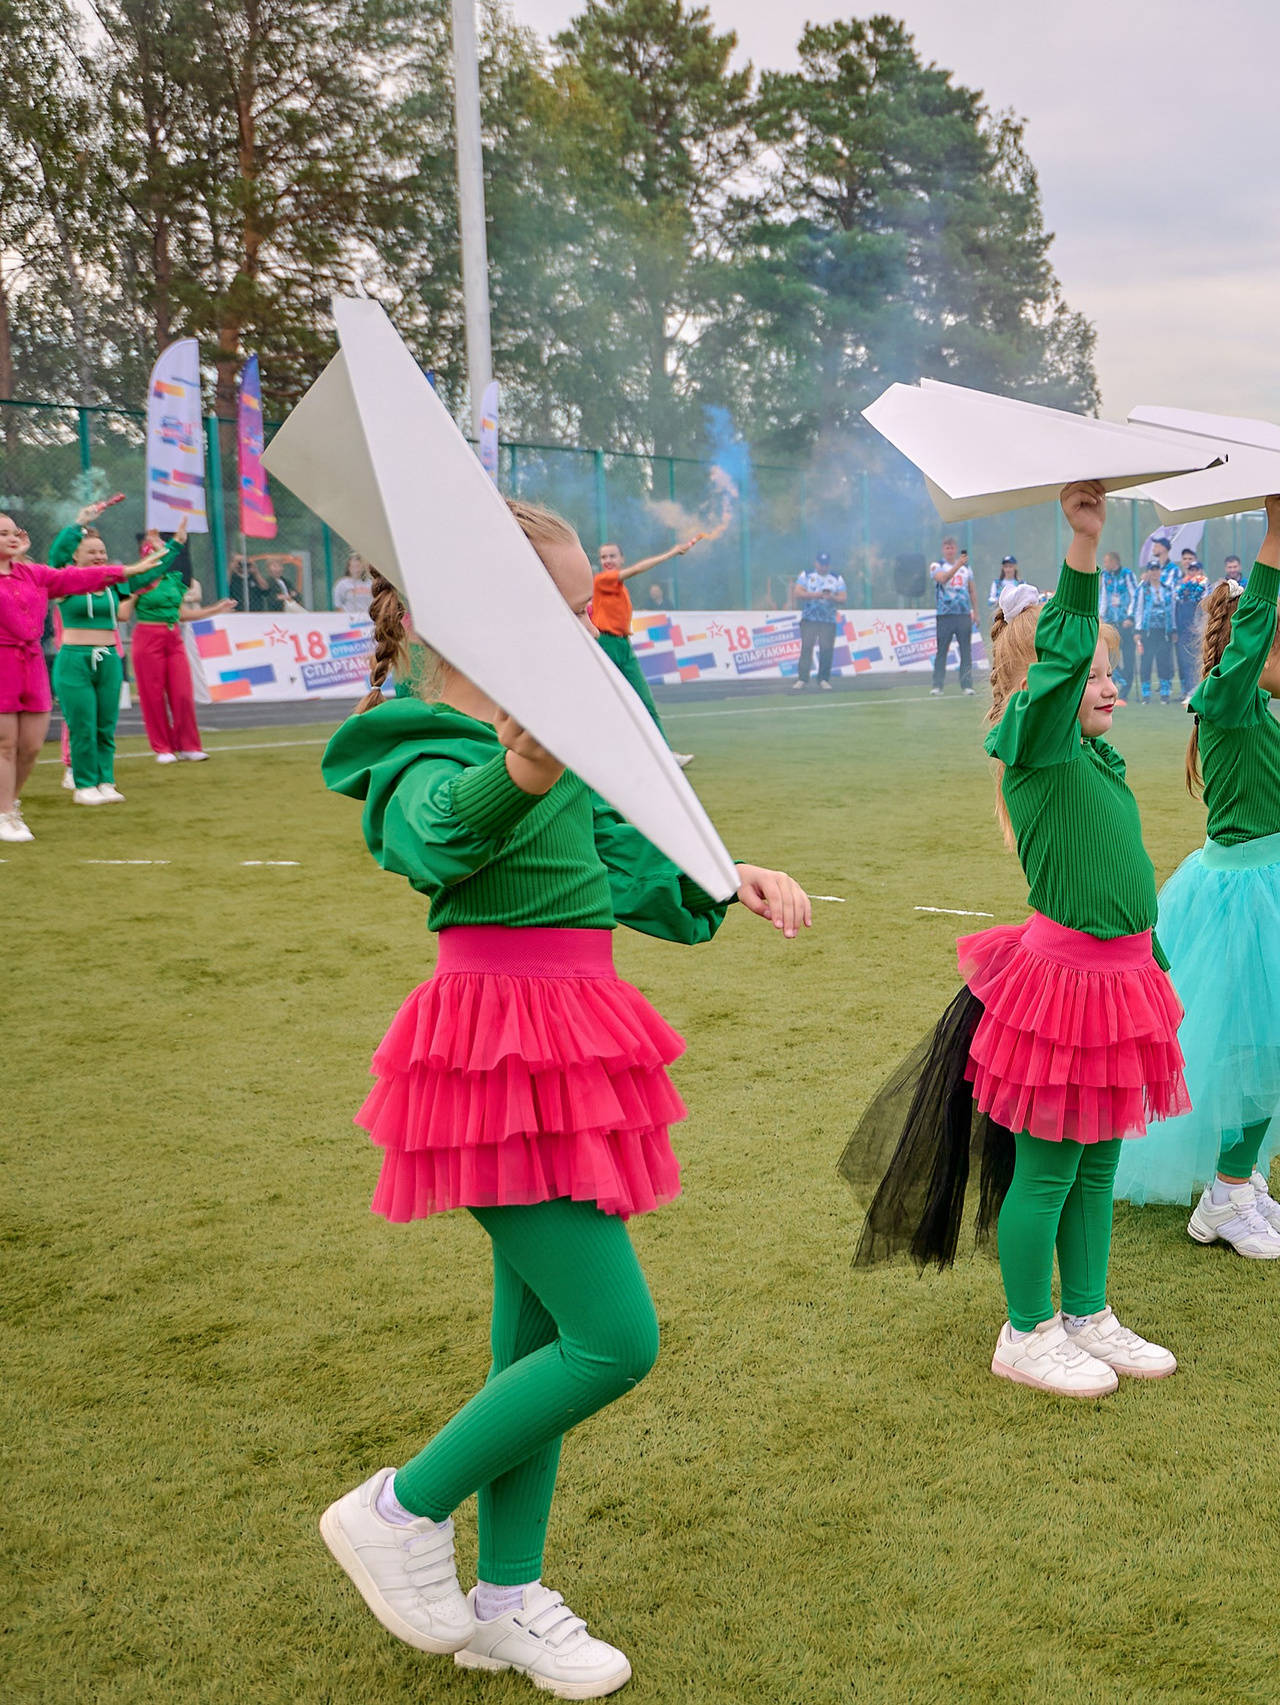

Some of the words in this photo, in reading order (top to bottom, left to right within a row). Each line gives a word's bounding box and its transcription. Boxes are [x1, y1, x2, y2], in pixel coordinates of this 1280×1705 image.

[724, 625, 752, 652] 18
[886, 622, 907, 646] 18
[290, 630, 328, 663] 18
[332, 640, 373, 655] ОТРАСЛЕ
[735, 642, 800, 664] СПАРТАКИАД
[304, 657, 370, 679] СПАРТАК
